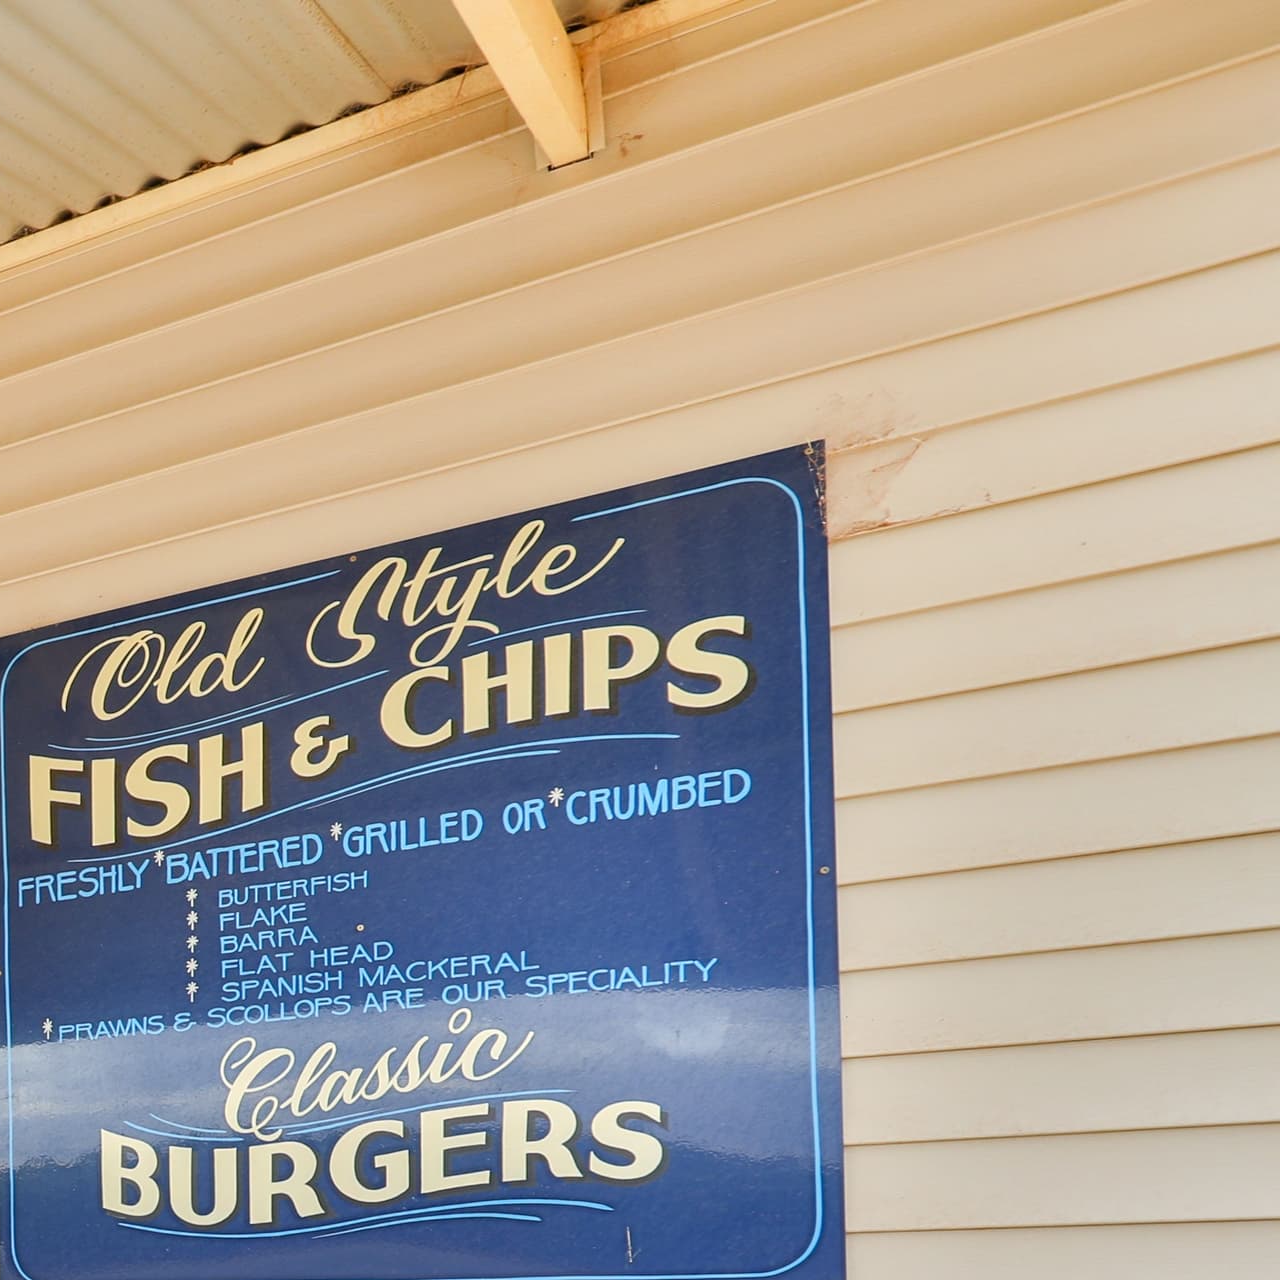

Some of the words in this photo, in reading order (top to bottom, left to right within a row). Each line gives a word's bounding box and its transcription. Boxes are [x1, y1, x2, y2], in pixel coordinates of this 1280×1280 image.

[61, 606, 266, 721] Old
[306, 518, 626, 668] Style
[28, 721, 264, 847] FISH
[289, 715, 349, 778] &
[379, 615, 750, 749] CHIPS
[17, 858, 151, 907] FRESHLY
[165, 833, 323, 885] BATTERED
[342, 808, 484, 857] GRILLED
[502, 798, 547, 835] OR
[565, 768, 752, 826] CRUMBED
[217, 870, 369, 909] BUTTERFISH
[219, 902, 309, 931] FLAKE
[220, 925, 319, 954] BARRA
[220, 970, 343, 1002] SPANISH
[358, 949, 540, 988] MACKERAL
[221, 953, 294, 978] FLAT
[309, 941, 394, 969] HEAD
[58, 1015, 165, 1043] PRAWNS
[173, 1012, 198, 1033] &
[206, 995, 352, 1029] SCOLLOPS
[362, 986, 426, 1014] ARE
[440, 979, 506, 1006] OUR
[524, 957, 718, 999] SPECIALITY
[220, 1008, 535, 1141] Classic
[100, 1099, 664, 1227] BURGERS
